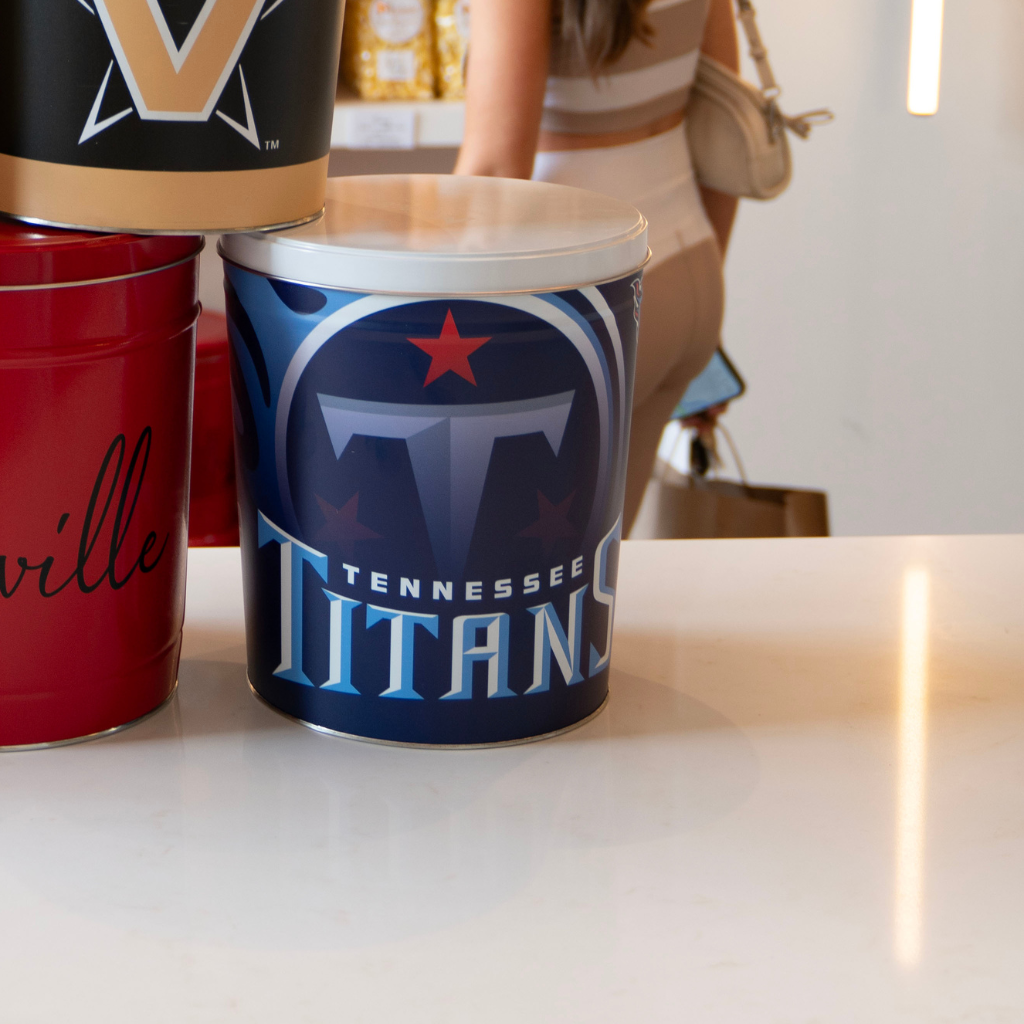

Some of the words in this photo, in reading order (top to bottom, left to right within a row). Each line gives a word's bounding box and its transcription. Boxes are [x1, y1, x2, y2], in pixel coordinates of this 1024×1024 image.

[264, 139, 280, 151] TM
[342, 554, 584, 602] TENNESSEE
[257, 508, 622, 701] TITANS
